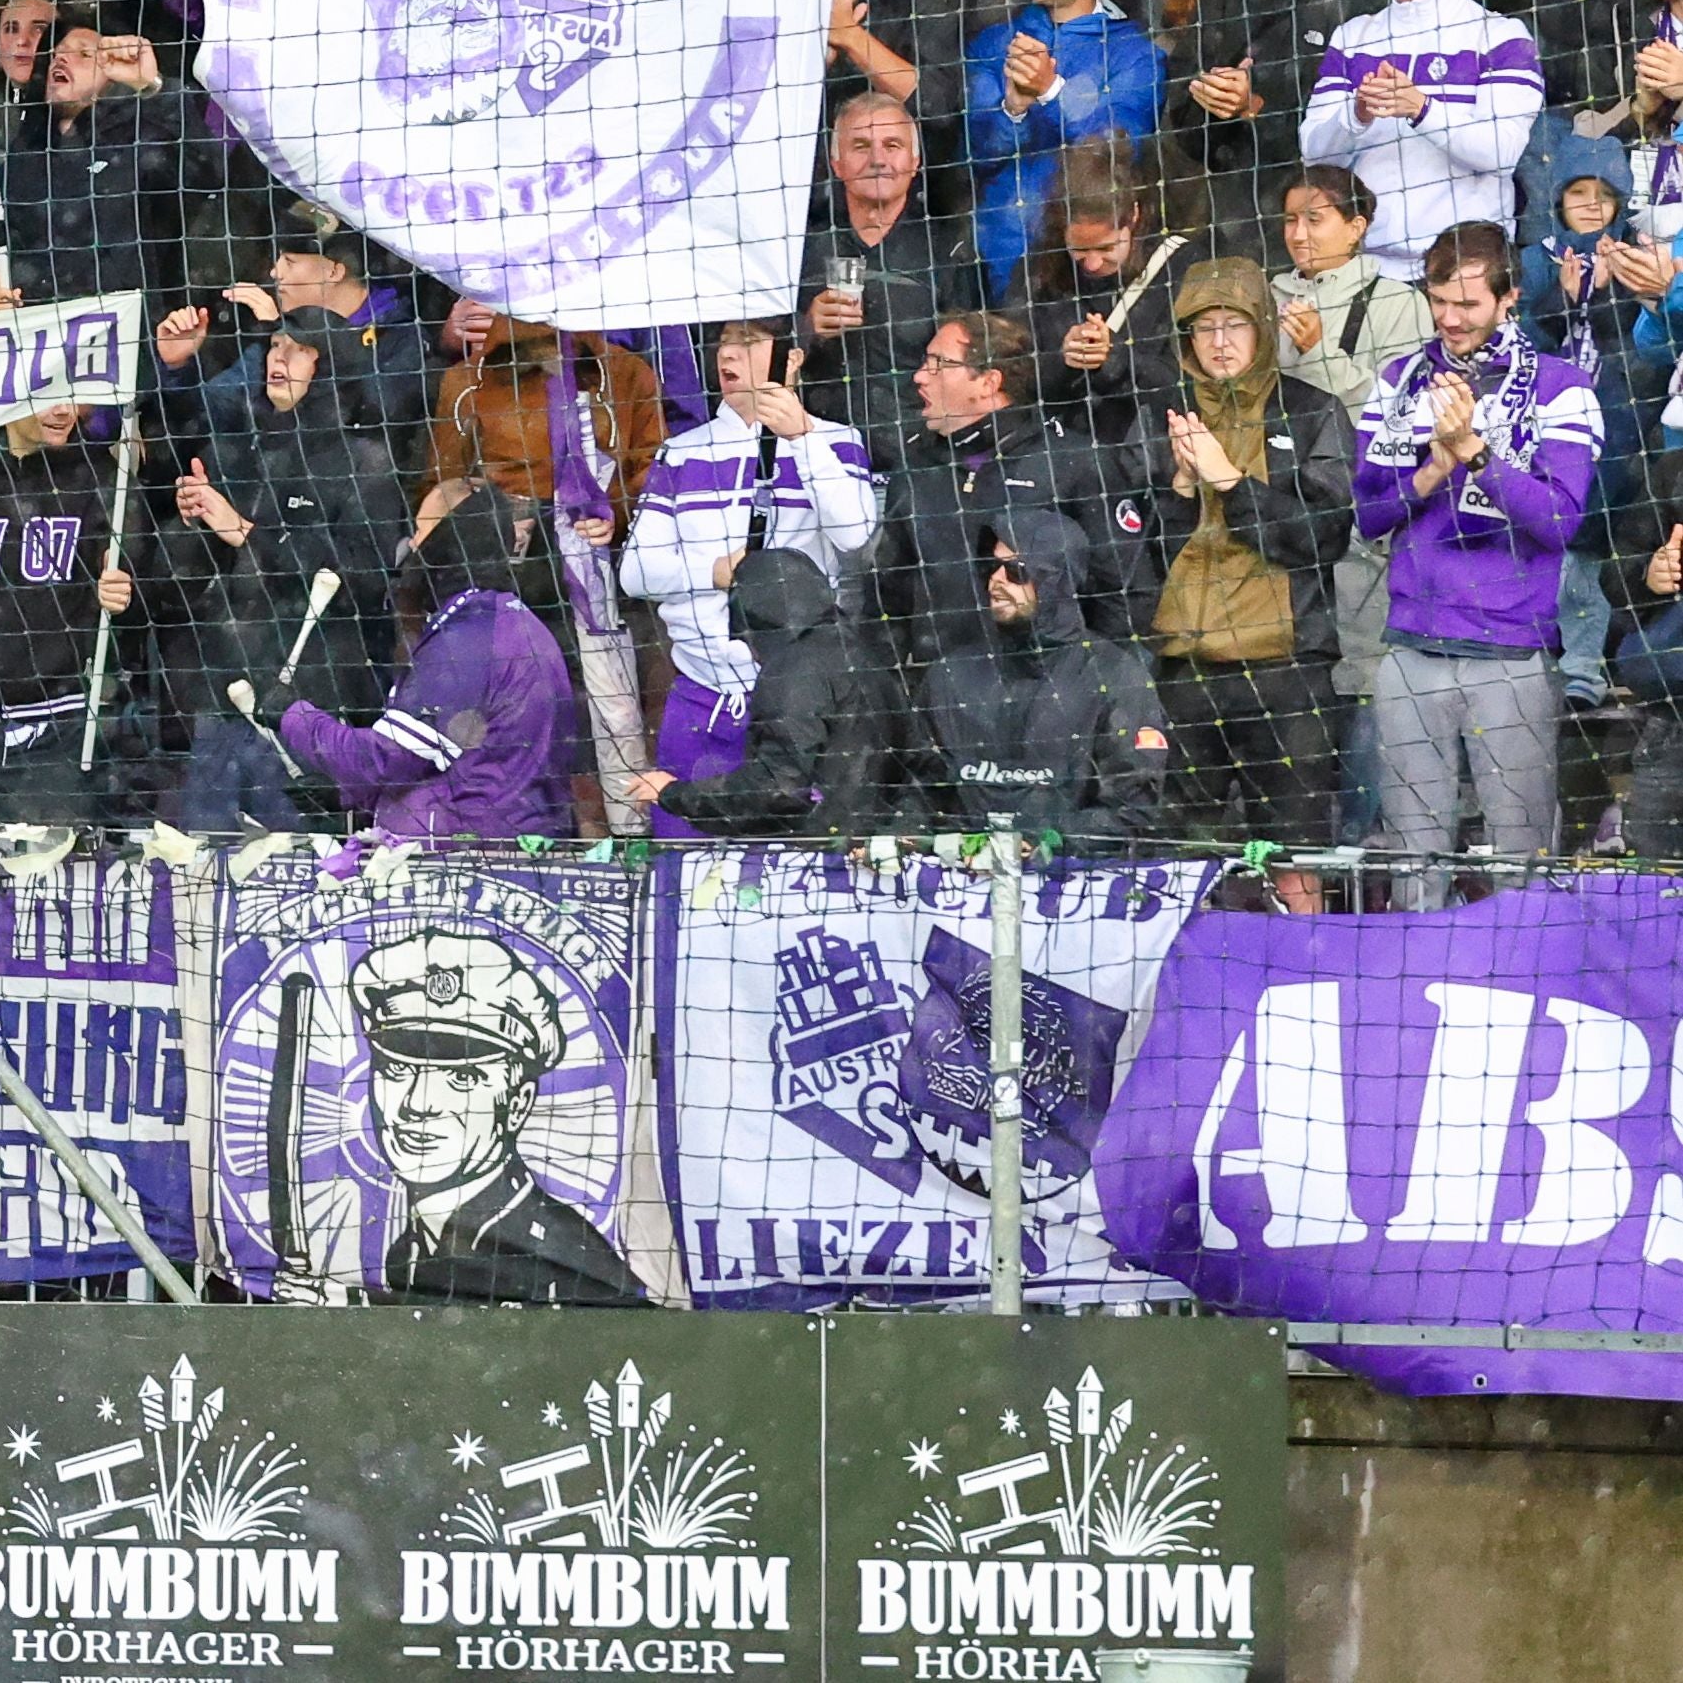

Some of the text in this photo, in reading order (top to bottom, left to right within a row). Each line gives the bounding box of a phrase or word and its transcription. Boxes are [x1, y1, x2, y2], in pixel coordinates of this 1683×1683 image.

[20, 516, 82, 583] 07
[959, 759, 1054, 786] ellesse
[1197, 981, 1683, 1267] AB
[400, 1550, 790, 1631] BUMMBUMM
[857, 1558, 1255, 1640] BUMMBUMM
[12, 1622, 284, 1667] HÖRHAGER
[456, 1629, 734, 1674] HÖRHAGER
[913, 1637, 1101, 1683] HÖRHA
